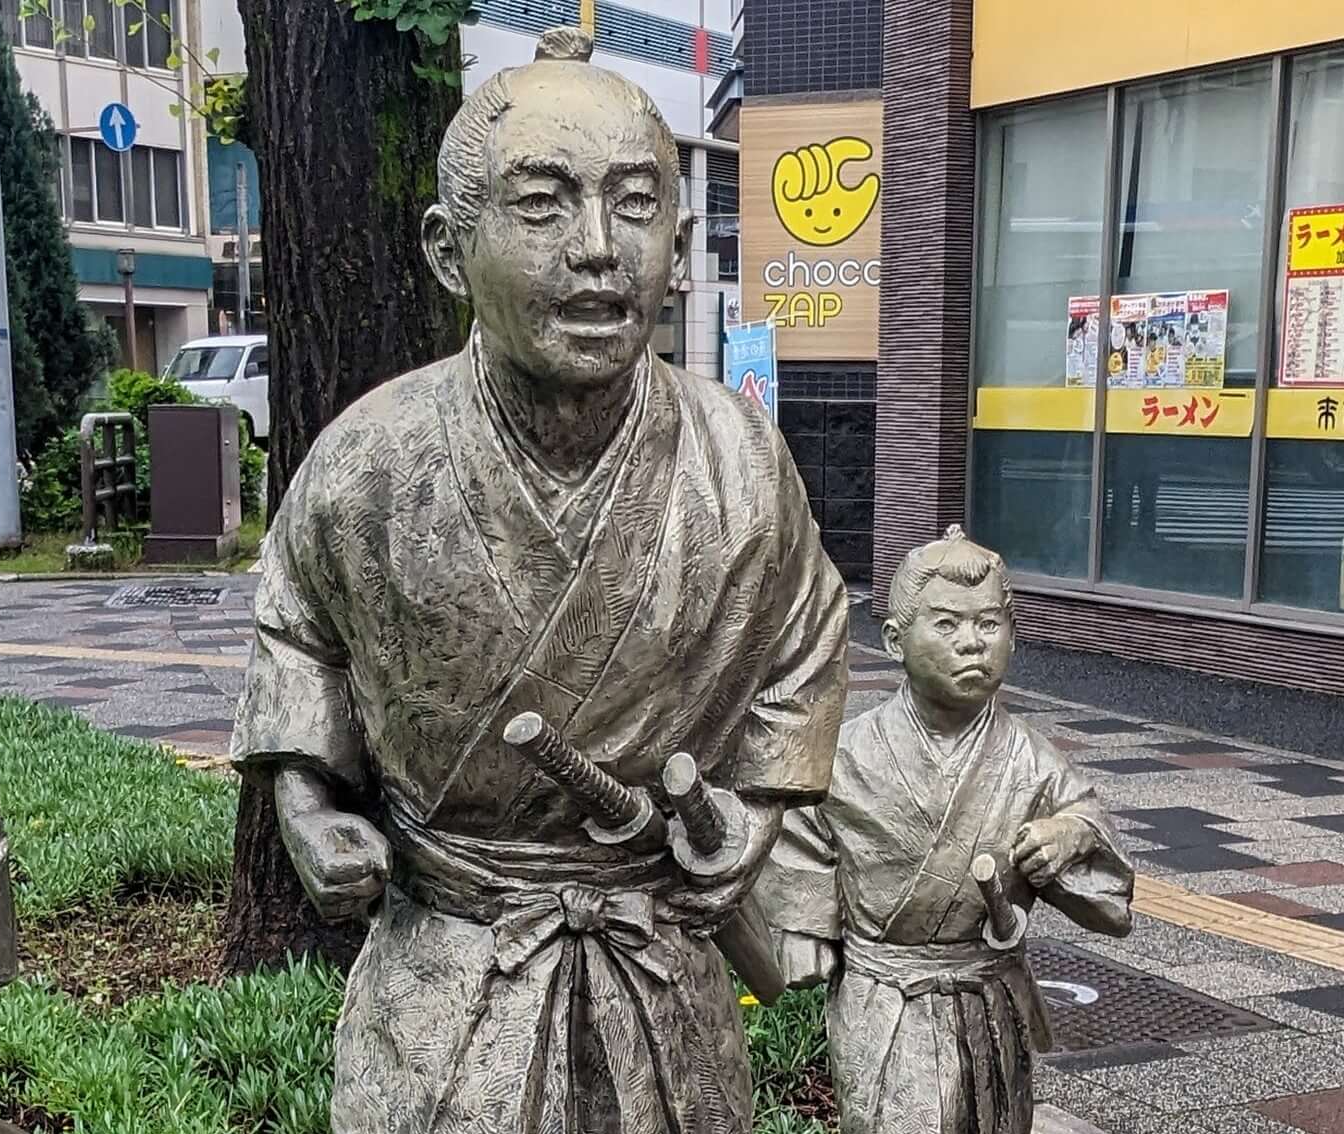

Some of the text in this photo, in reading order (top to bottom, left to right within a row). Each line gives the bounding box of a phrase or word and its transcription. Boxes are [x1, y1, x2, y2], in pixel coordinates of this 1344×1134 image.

[763, 292, 843, 327] ZAP
[1142, 396, 1220, 429] ラーメン
